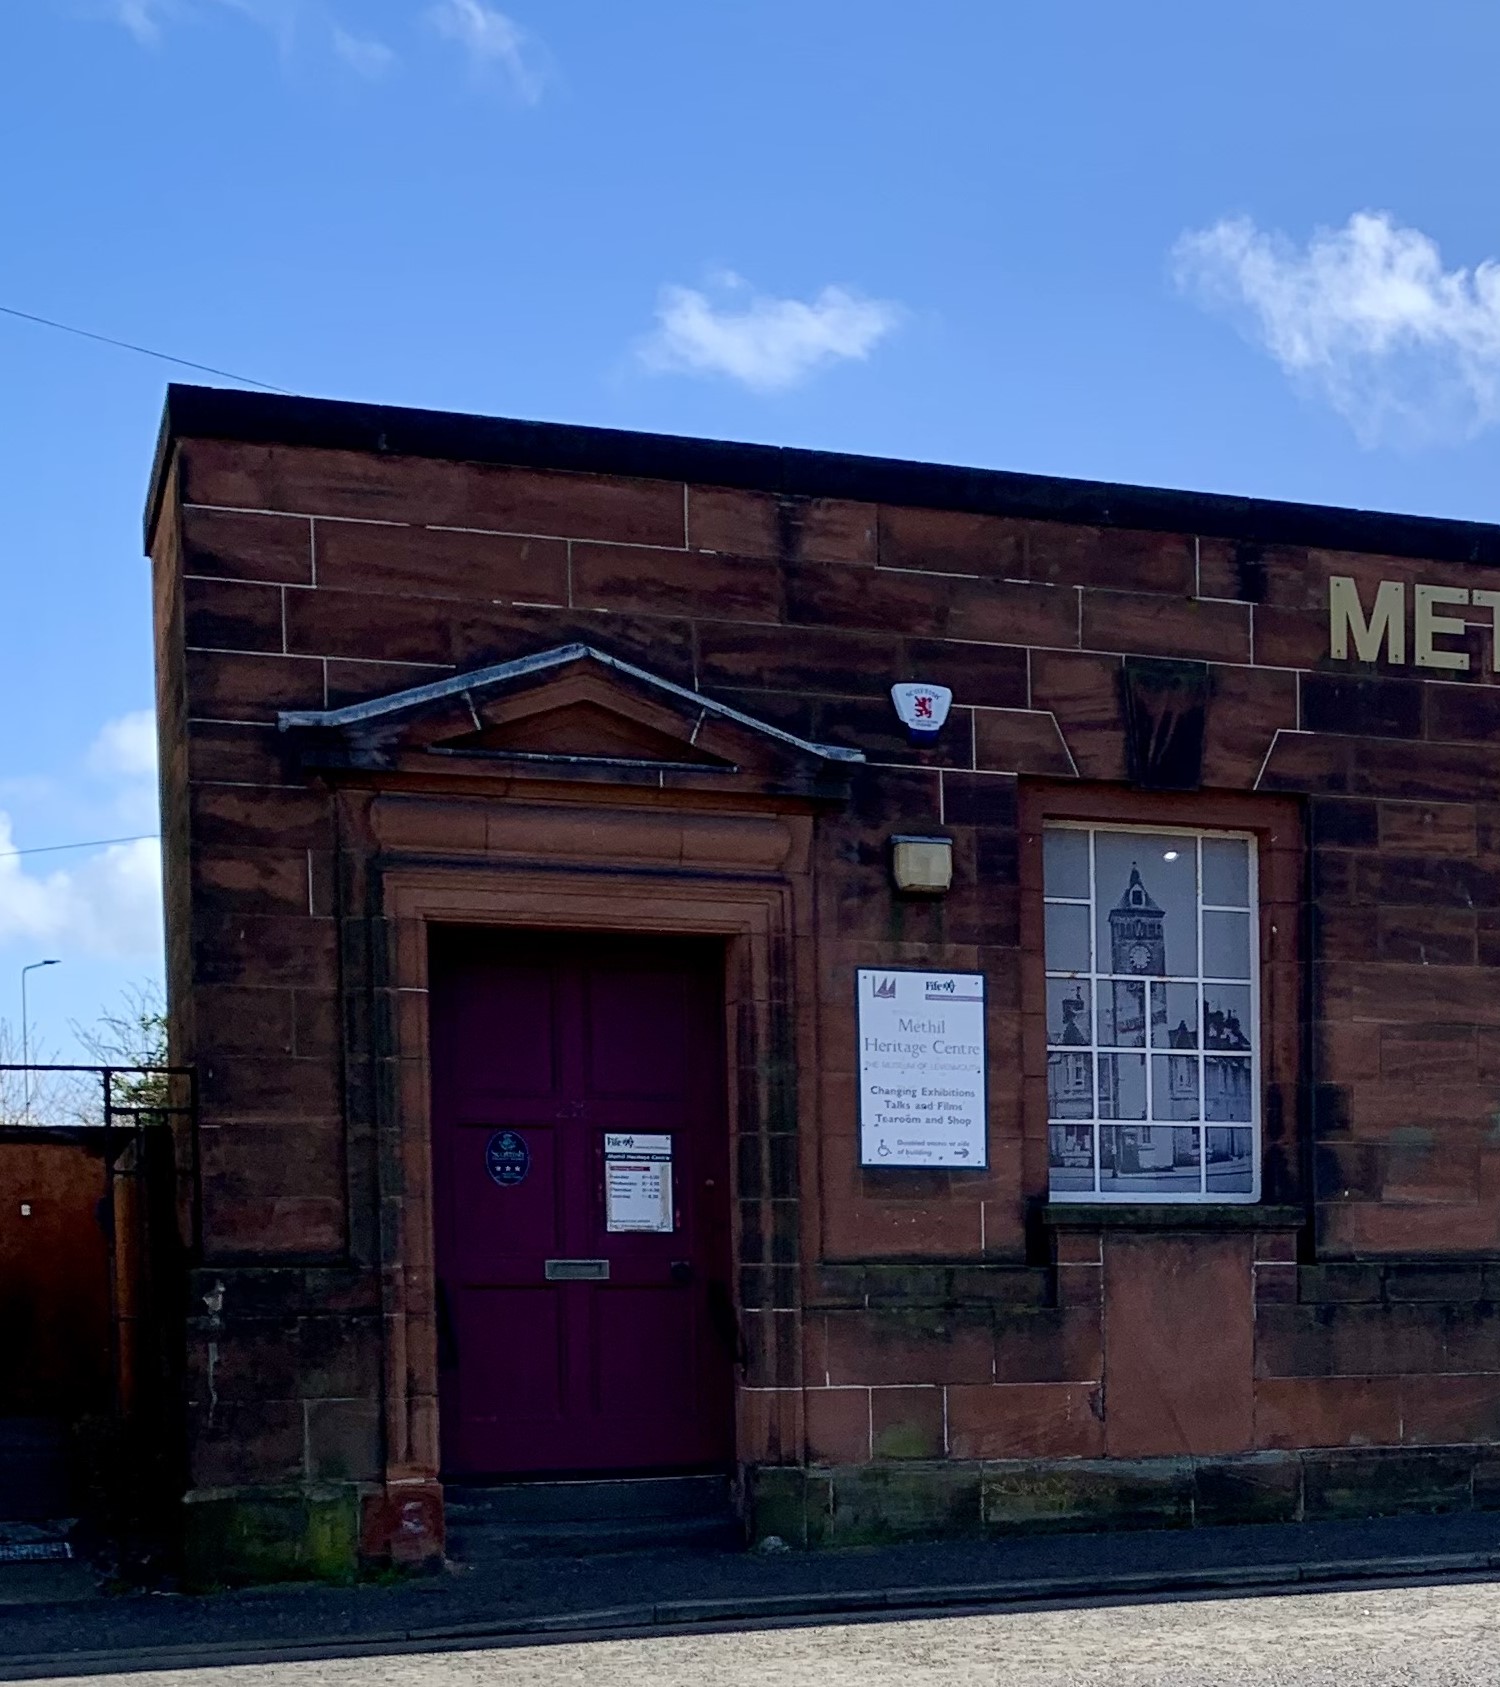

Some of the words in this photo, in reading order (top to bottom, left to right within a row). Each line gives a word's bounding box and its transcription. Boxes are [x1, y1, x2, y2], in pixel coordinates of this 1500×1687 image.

[925, 980, 943, 992] Fife
[898, 1018, 946, 1034] Methil
[864, 1037, 928, 1058] Heritage
[932, 1040, 981, 1056] Centre
[870, 1085, 918, 1098] Changing
[921, 1087, 976, 1098] Exhibitions
[884, 1100, 911, 1110] Talks
[915, 1101, 934, 1110] and
[937, 1101, 963, 1111] Films
[874, 1113, 922, 1124] Tearoom
[925, 1115, 944, 1124] and
[947, 1115, 972, 1127] Shop
